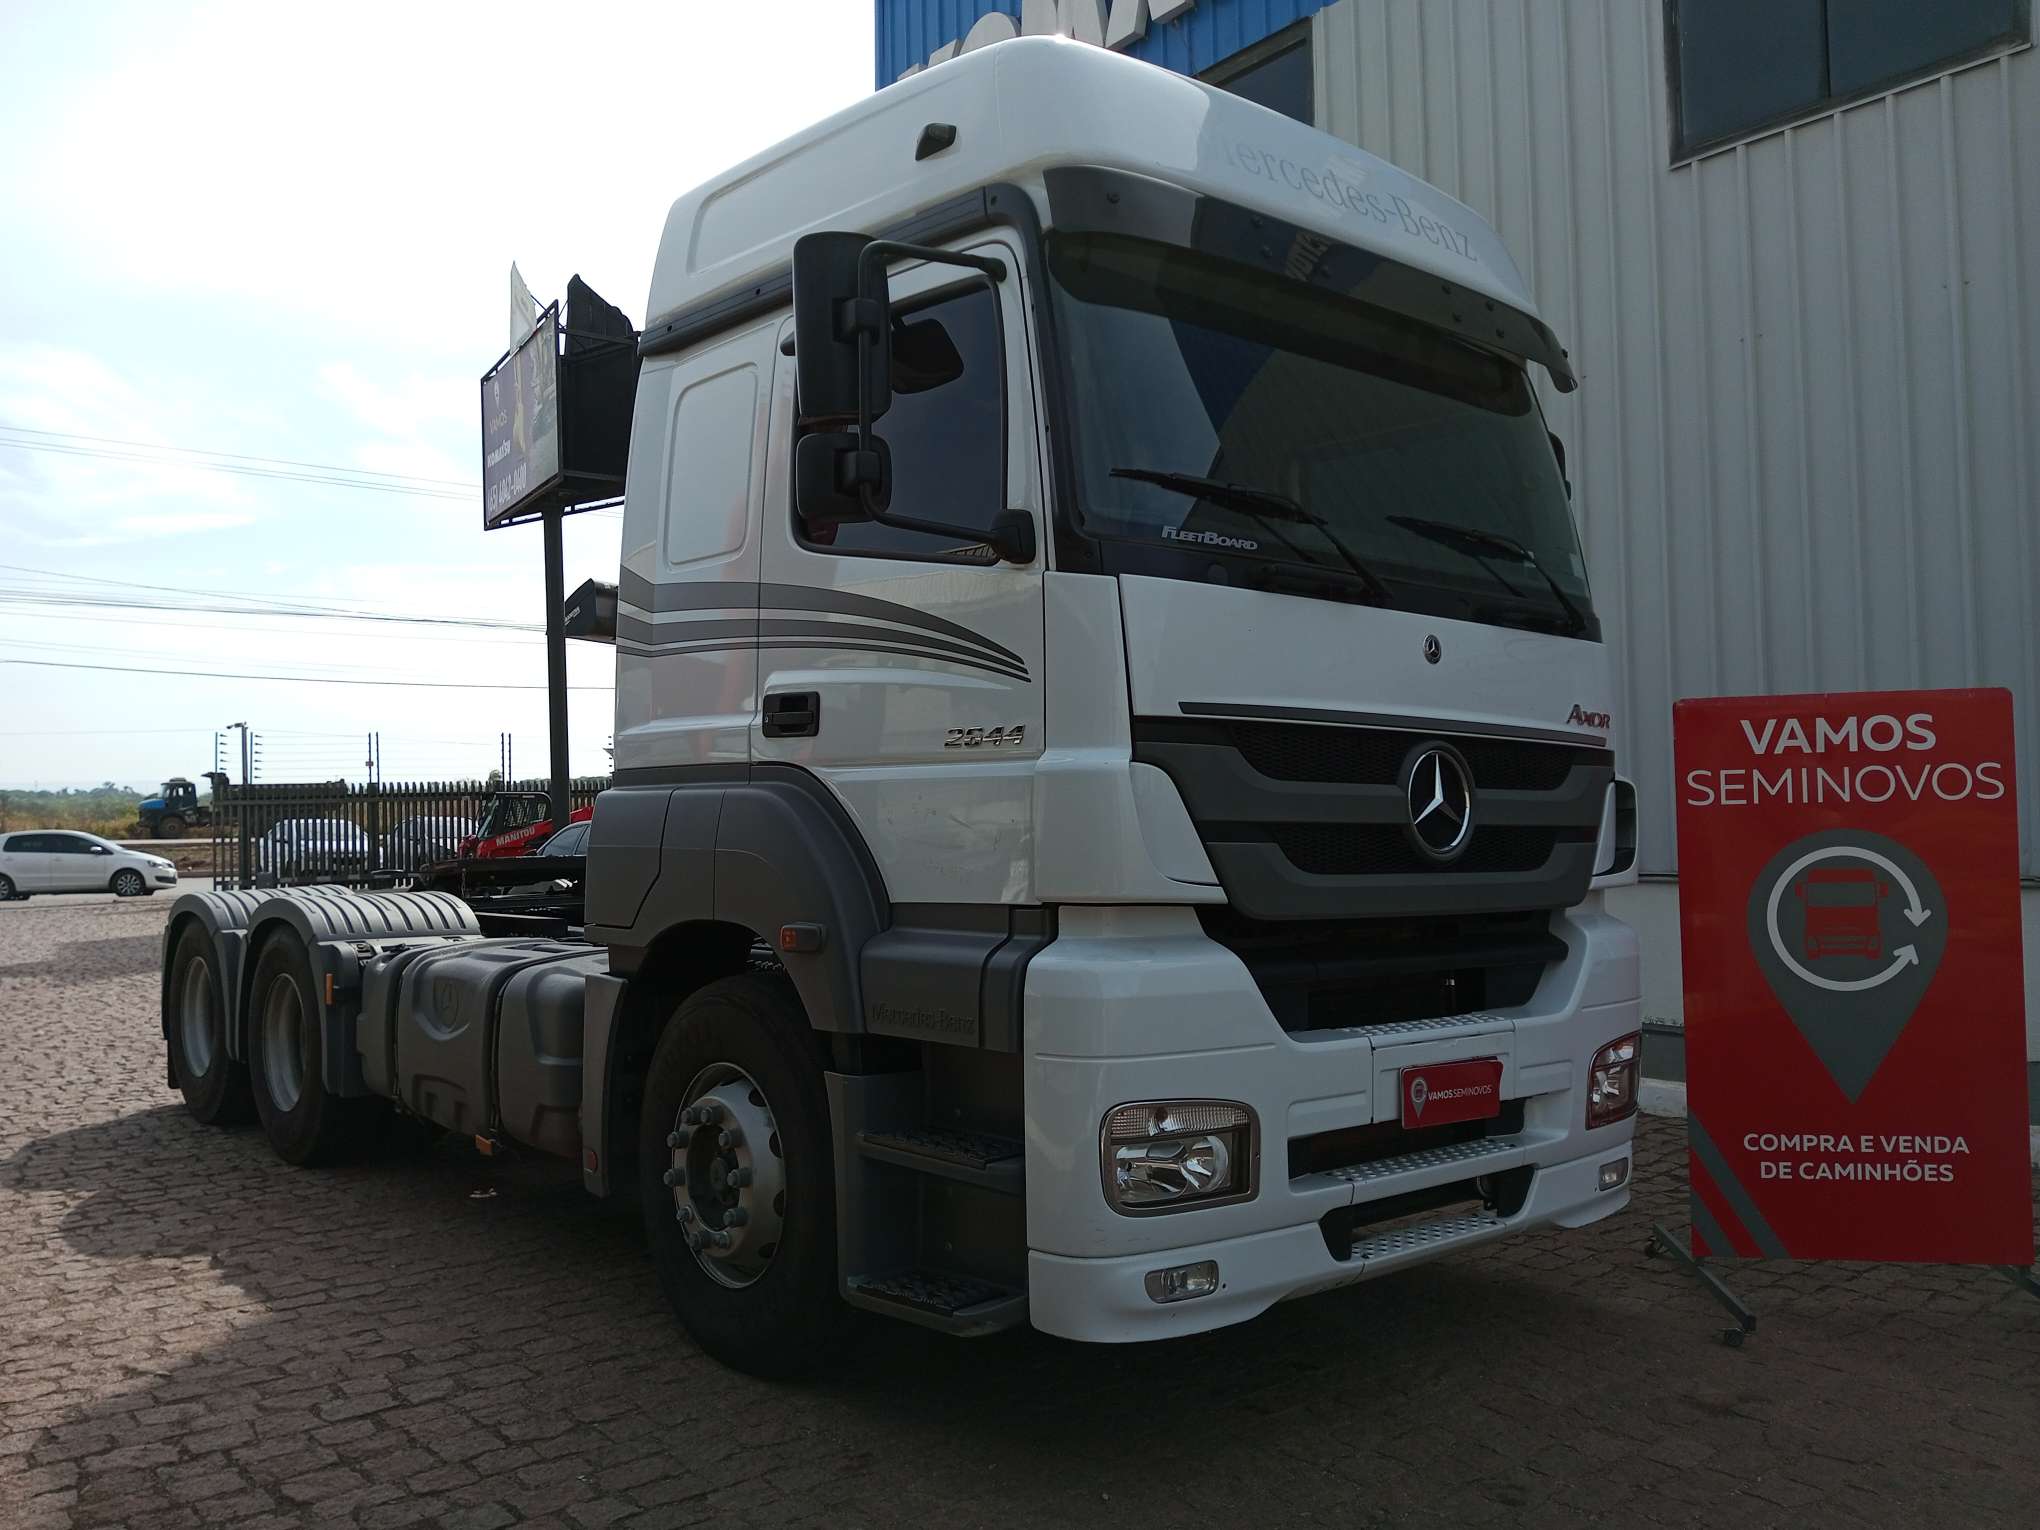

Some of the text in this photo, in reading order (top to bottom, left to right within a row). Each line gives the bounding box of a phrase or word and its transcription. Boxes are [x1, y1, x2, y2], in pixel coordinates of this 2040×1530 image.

[1740, 713, 1937, 755] VAMOS
[1686, 762, 2006, 806] SEMINOVOS
[495, 825, 536, 847] MANITOU
[1743, 1133, 1971, 1154] COMPRA E VENDA
[1760, 1159, 1955, 1182] DE CAMINHÕES
